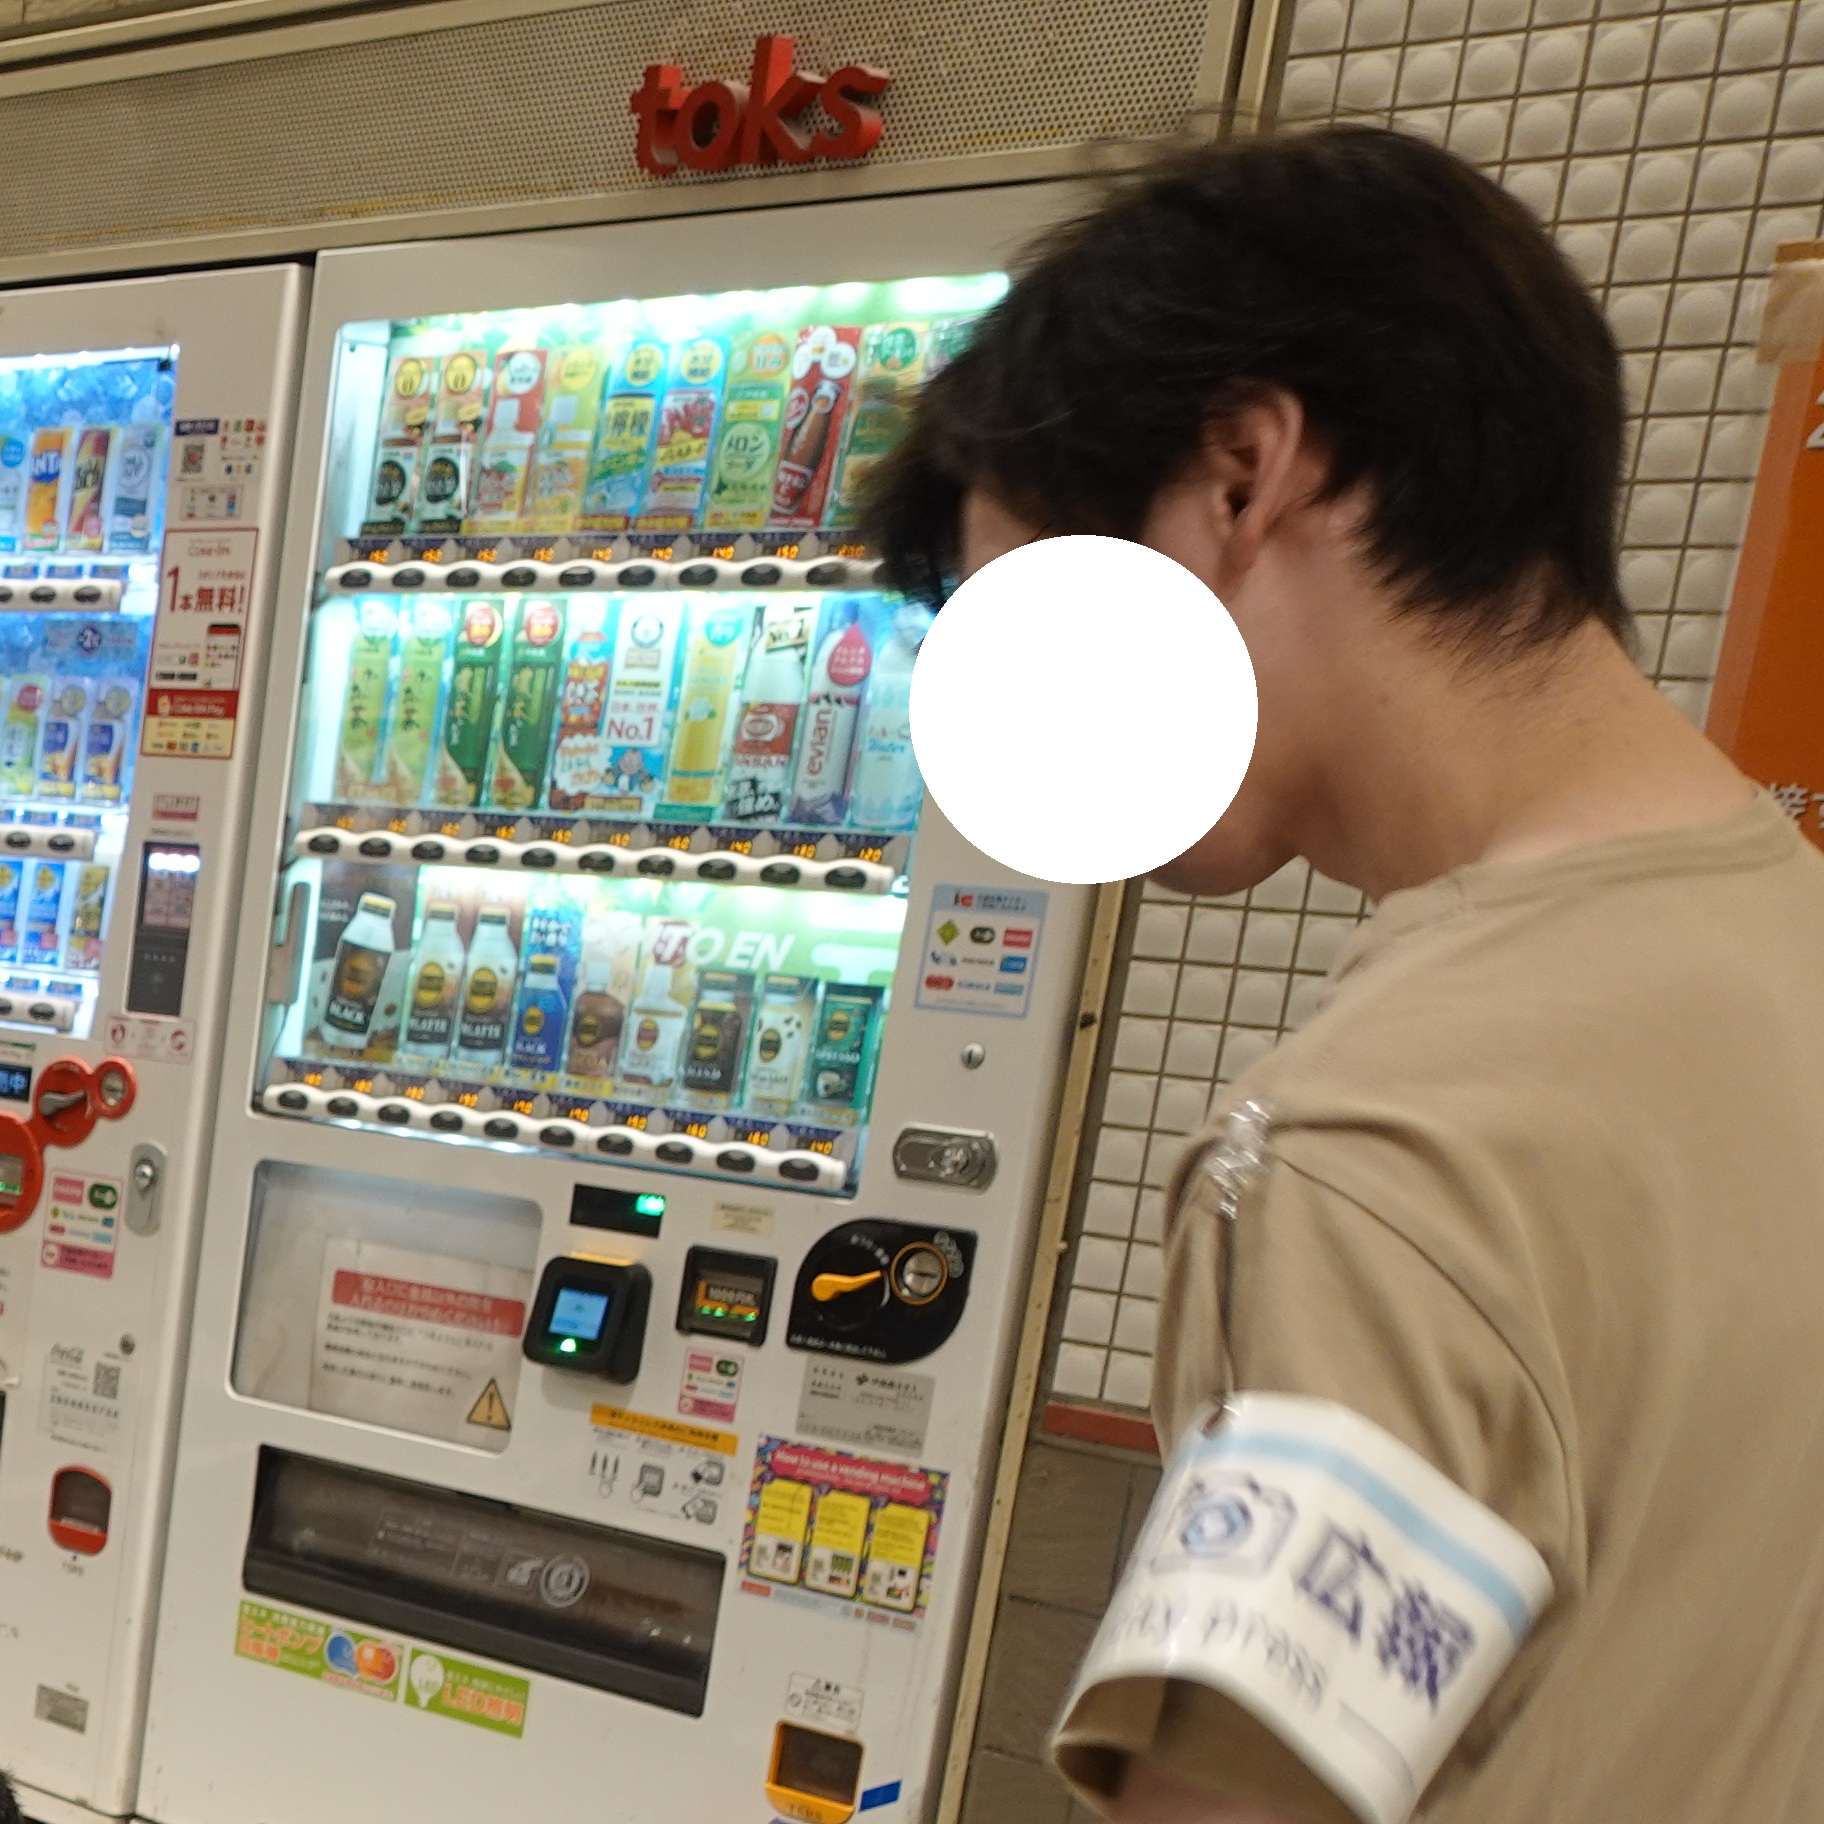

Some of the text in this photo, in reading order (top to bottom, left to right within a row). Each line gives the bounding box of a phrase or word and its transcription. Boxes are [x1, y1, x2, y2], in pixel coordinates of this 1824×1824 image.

[630, 34, 890, 175] toks
[607, 716, 654, 742] No.1
[807, 708, 834, 777] evian
[725, 930, 794, 970] EN
[1292, 1513, 1476, 1714] 広報
[442, 1684, 525, 1726] LED照明
